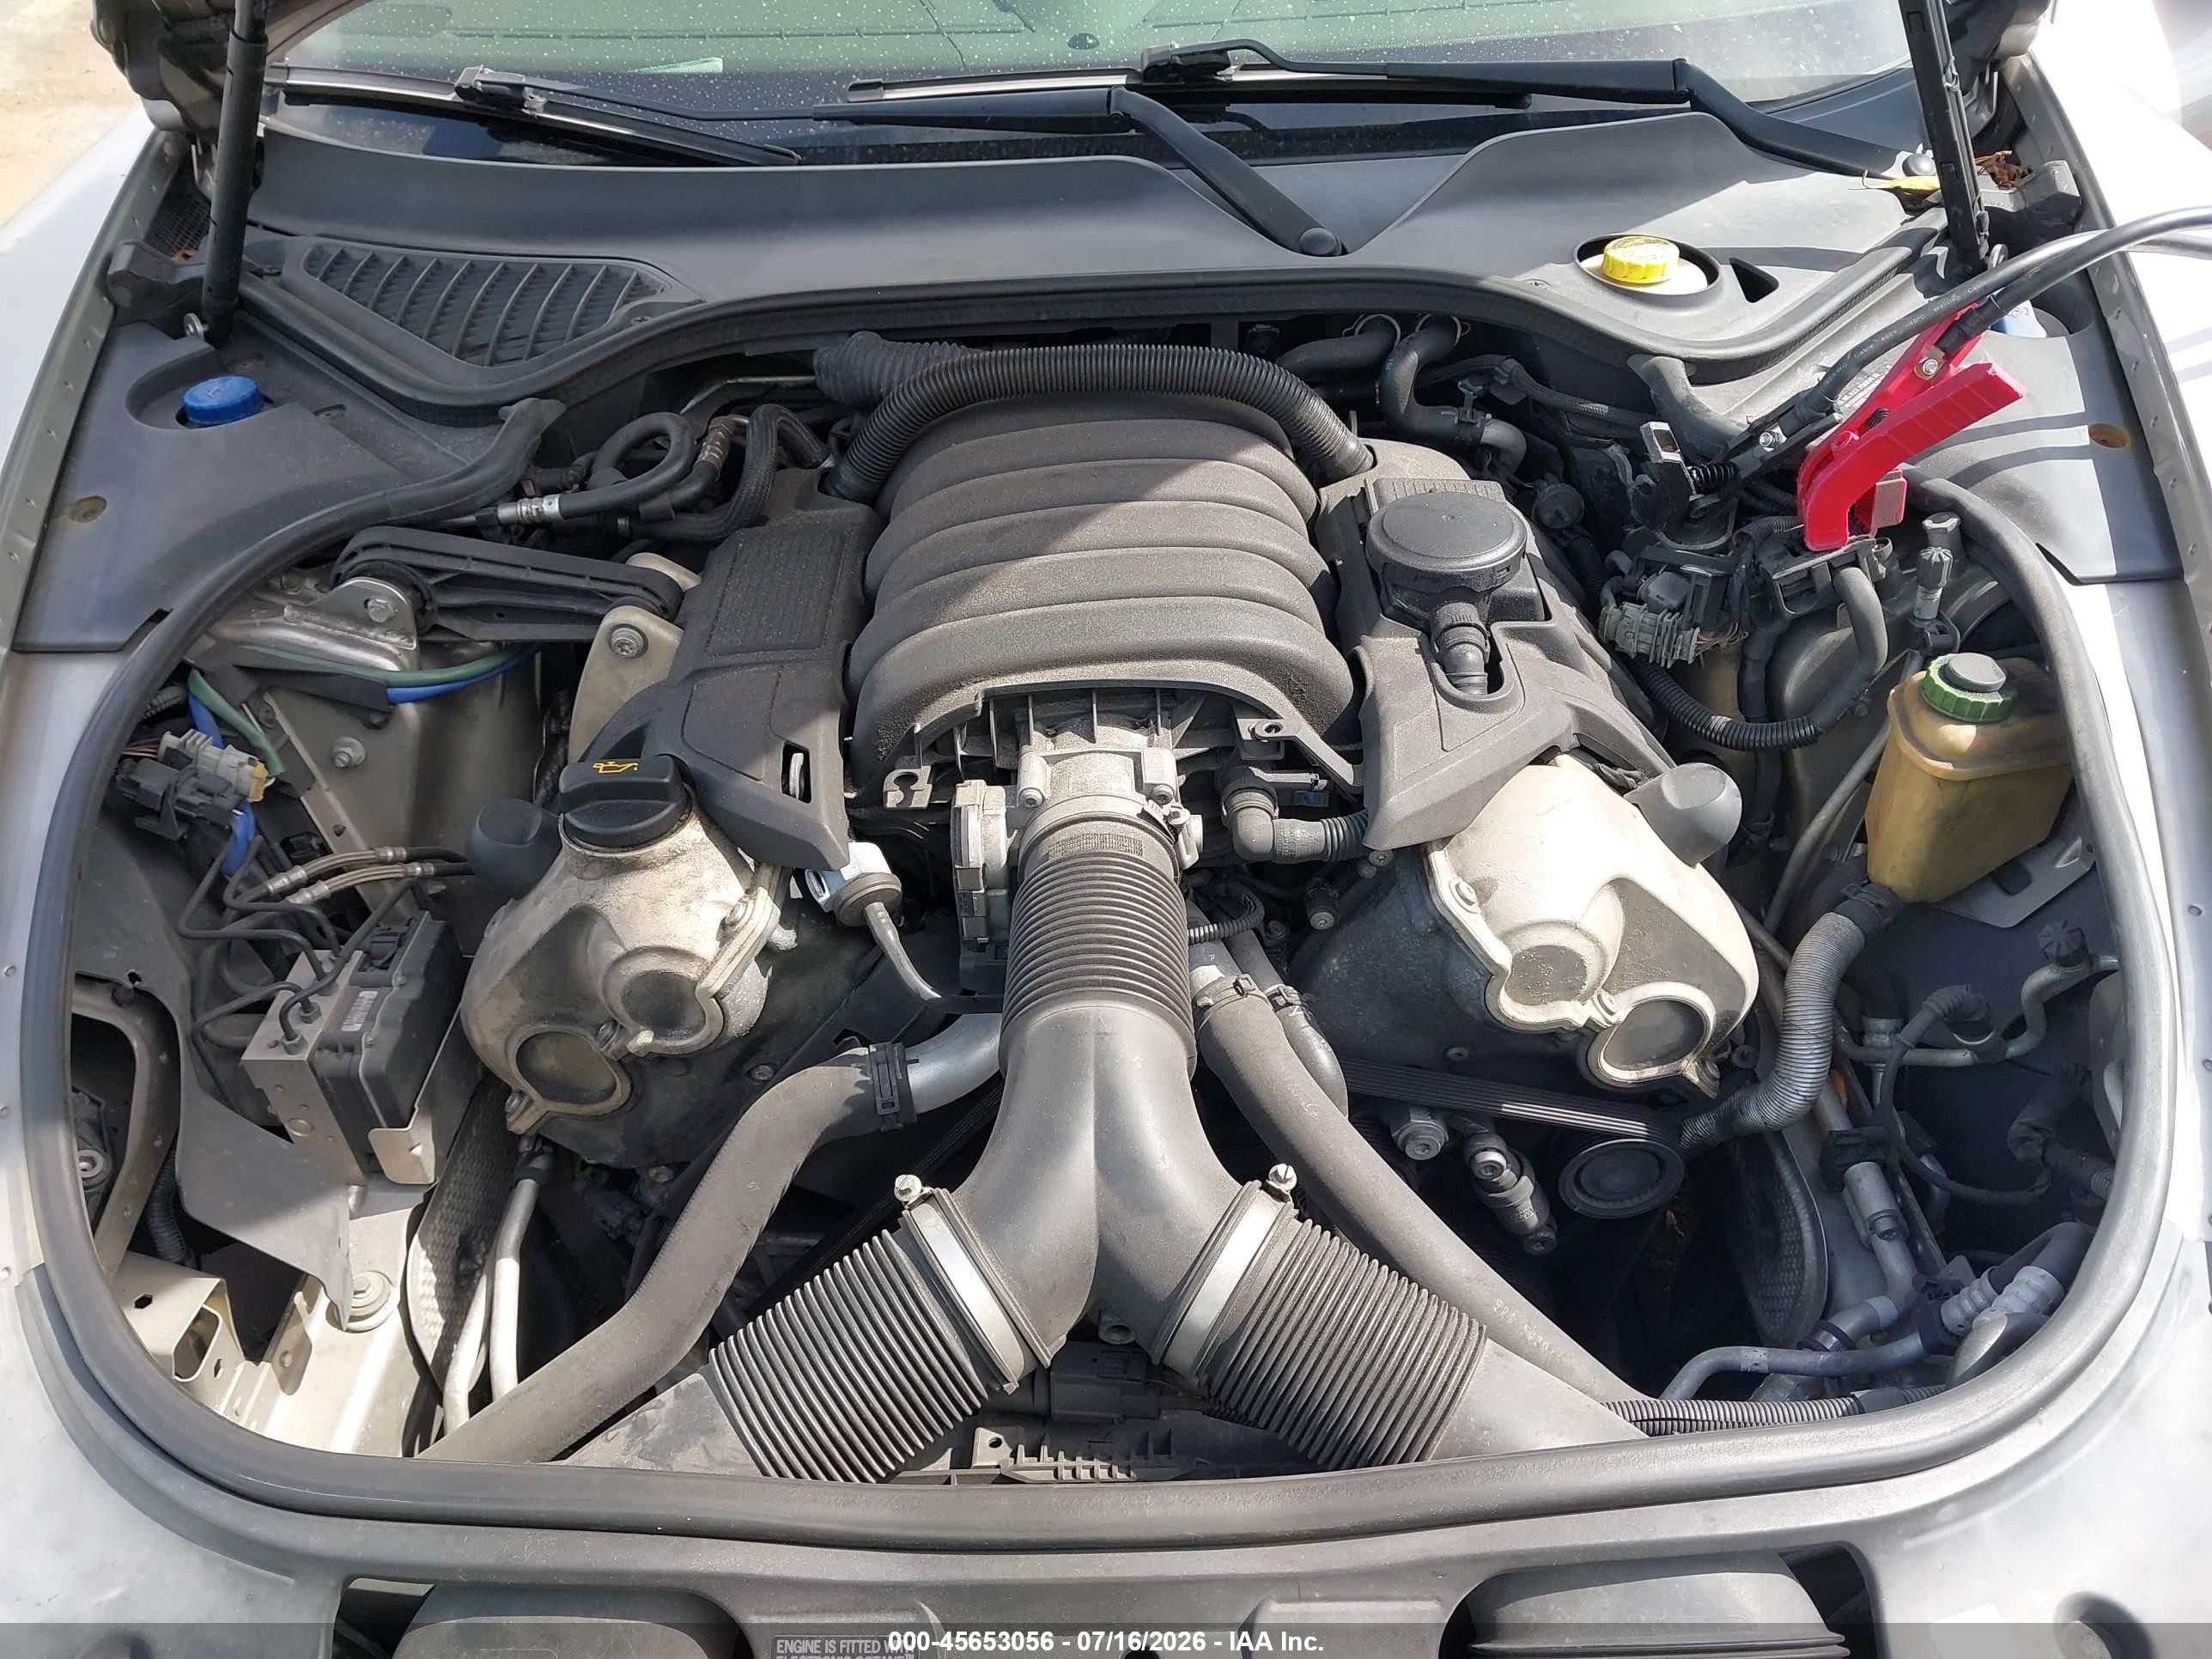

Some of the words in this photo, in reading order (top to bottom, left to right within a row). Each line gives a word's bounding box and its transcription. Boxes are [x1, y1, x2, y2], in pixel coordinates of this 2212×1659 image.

[1854, 343, 1875, 358] Cable
[1933, 295, 1961, 312] Welding
[776, 1639, 821, 1654] ENGINE
[824, 1639, 836, 1654] IS
[839, 1639, 881, 1654] FITTED
